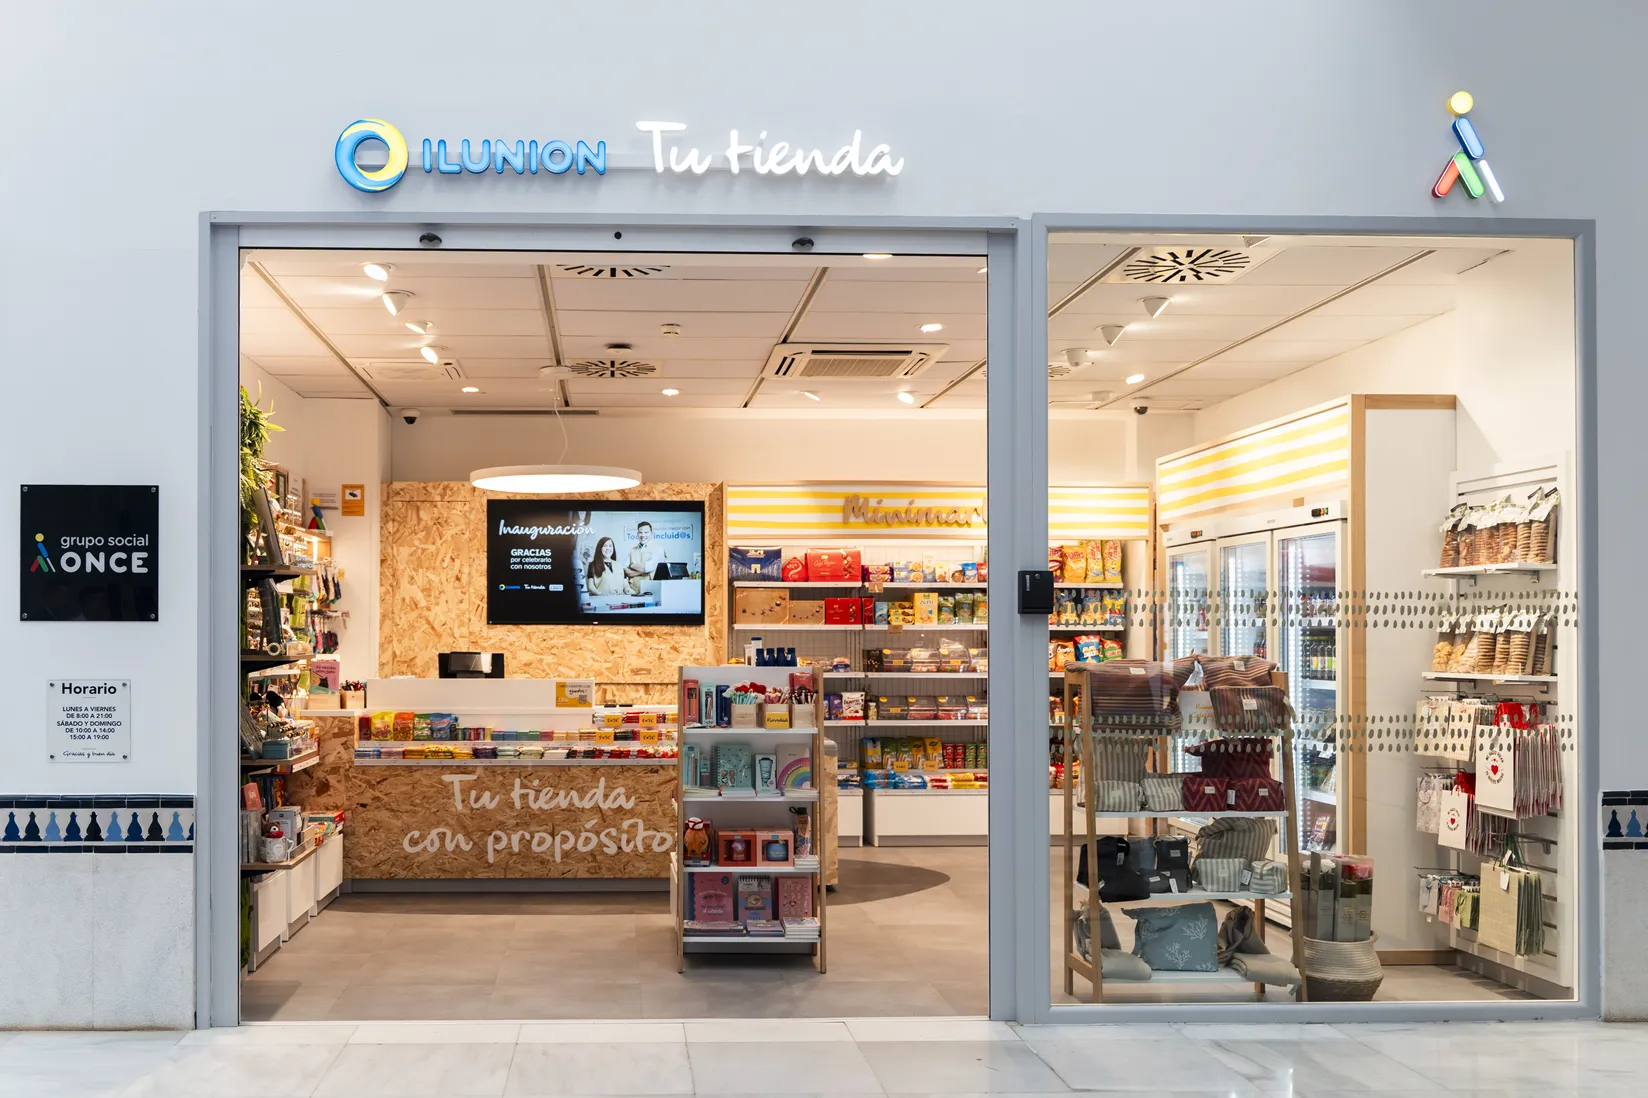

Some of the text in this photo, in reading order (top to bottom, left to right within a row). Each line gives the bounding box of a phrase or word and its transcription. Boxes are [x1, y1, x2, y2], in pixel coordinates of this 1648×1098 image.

[422, 121, 905, 177] ILUNION Tu tienda
[499, 519, 595, 540] Inauguración
[653, 532, 691, 540] incluid@s
[60, 533, 149, 549] grupo social
[60, 551, 149, 573] ONCE
[510, 548, 552, 556] GRACIAS
[62, 682, 117, 695] Horario
[441, 774, 635, 810] Tu tienda
[403, 818, 674, 864] con propósito
